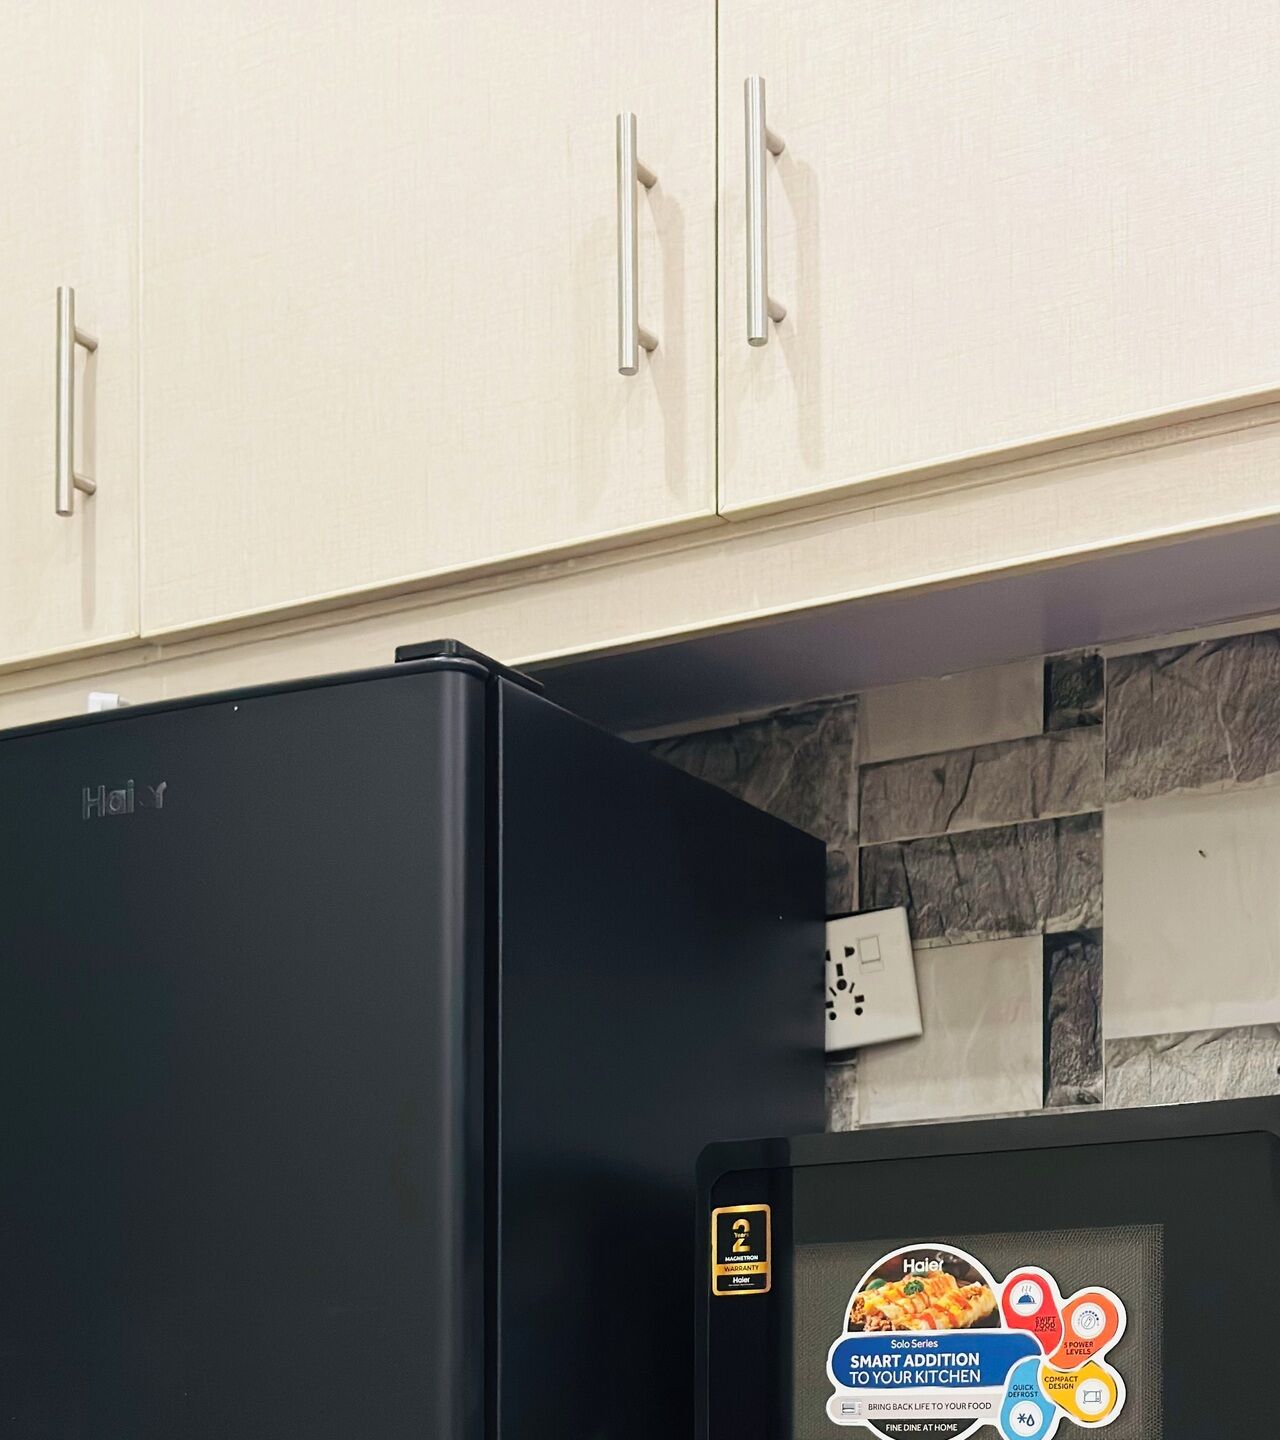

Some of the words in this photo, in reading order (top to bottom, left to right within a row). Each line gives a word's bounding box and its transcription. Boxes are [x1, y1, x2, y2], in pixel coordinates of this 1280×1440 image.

[82, 779, 167, 820] Hair
[732, 1218, 750, 1252] 2
[903, 1257, 944, 1273] Haier
[891, 1339, 909, 1348] Solo
[911, 1339, 938, 1348] Series
[850, 1354, 901, 1368] SMART
[904, 1352, 979, 1367] ADDITION
[850, 1371, 869, 1384] TO
[872, 1370, 912, 1384] YOUR
[915, 1369, 980, 1383] KITCHEN
